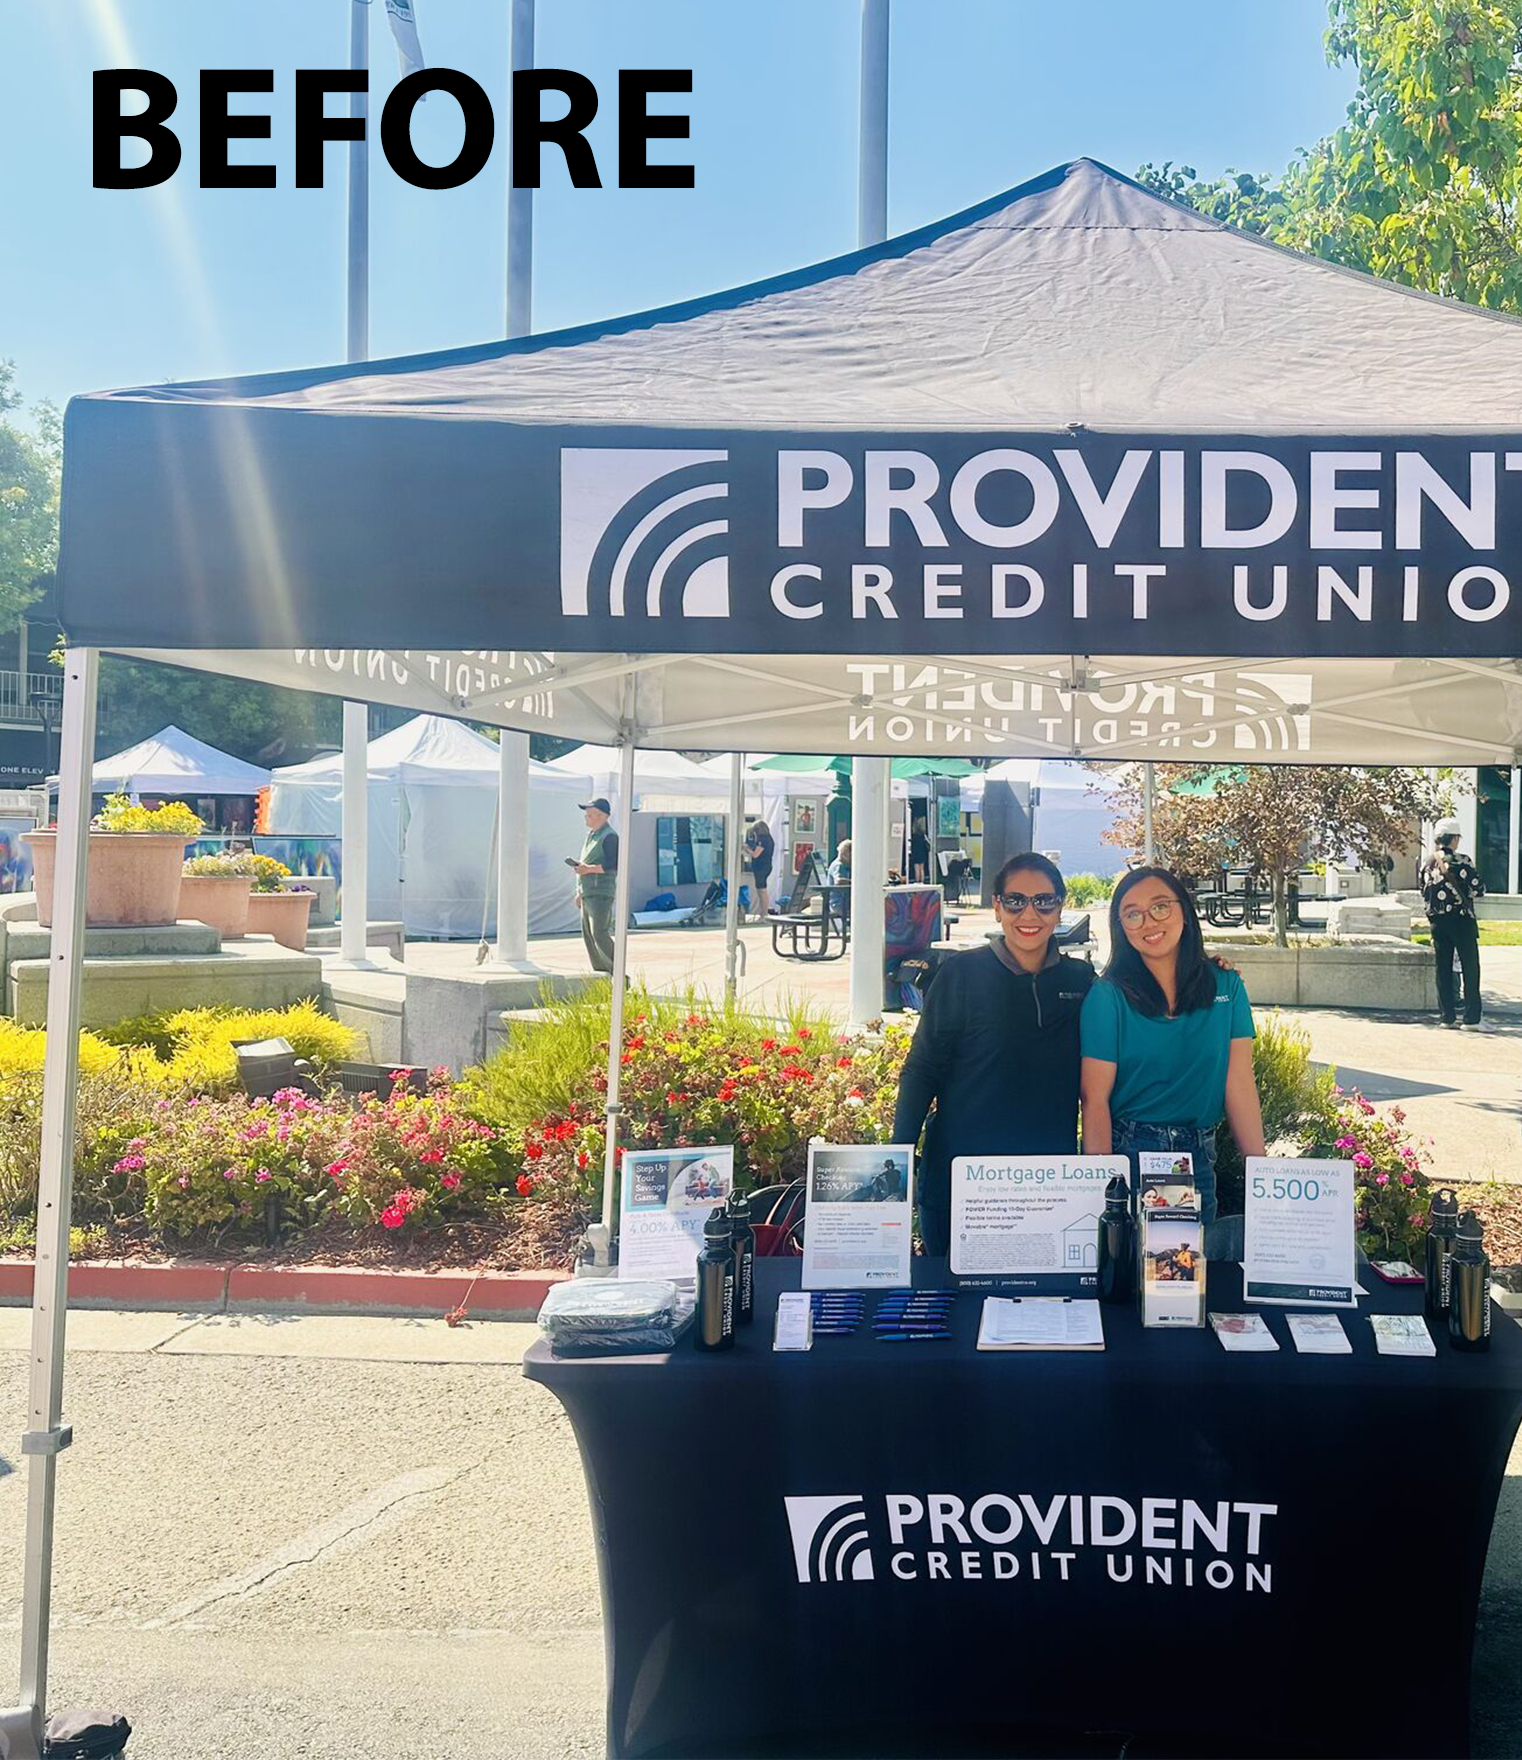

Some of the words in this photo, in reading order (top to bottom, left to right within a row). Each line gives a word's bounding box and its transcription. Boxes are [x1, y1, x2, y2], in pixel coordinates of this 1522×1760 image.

[769, 563, 1167, 620] CREDIT
[635, 1164, 653, 1174] Step
[655, 1163, 667, 1173] Up
[965, 1164, 1056, 1184] Mortgage
[1062, 1164, 1117, 1180] Loans
[1255, 1167, 1275, 1175] AUTO
[1275, 1167, 1300, 1176] LOANS
[635, 1174, 656, 1182] Your
[635, 1184, 666, 1193] Savings
[1252, 1177, 1320, 1201] 5.500
[634, 1194, 659, 1202] Game
[885, 1493, 1278, 1555] PROVIDENT
[890, 1551, 1077, 1580] CREDIT
[1106, 1553, 1273, 1593] UNION
